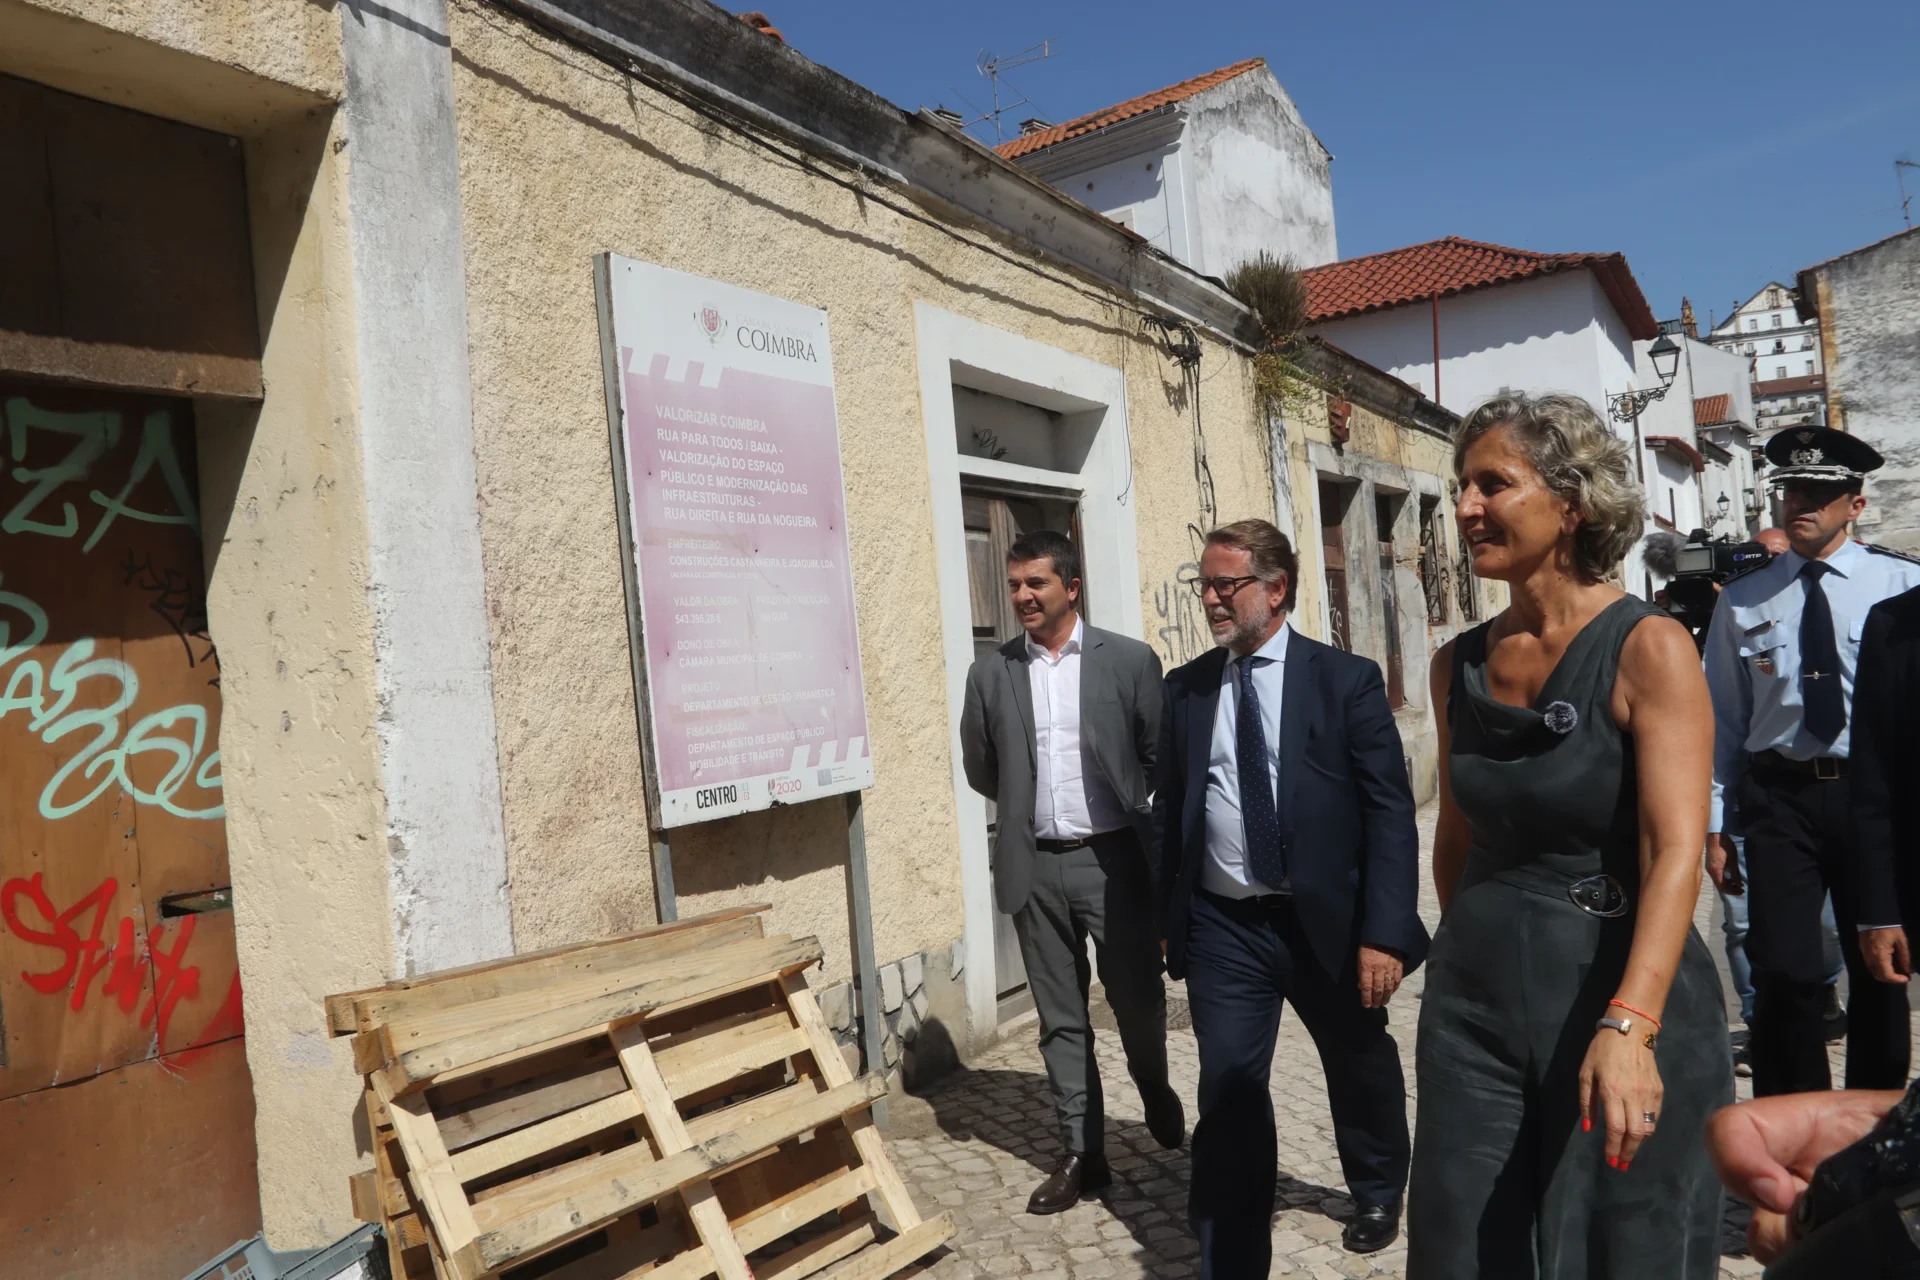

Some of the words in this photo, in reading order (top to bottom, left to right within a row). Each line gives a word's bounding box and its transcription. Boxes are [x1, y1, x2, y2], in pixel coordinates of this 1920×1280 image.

[736, 326, 818, 363] COIMBRA
[655, 404, 718, 426] VALORIZAR
[720, 414, 768, 433] COIMBRA
[657, 428, 679, 443] RUA
[681, 432, 709, 446] PARA
[711, 435, 744, 451] TODOS
[750, 440, 778, 455] BAIXA
[659, 450, 730, 469] VALORIZAÇÃO
[731, 457, 746, 470] DO
[748, 459, 784, 476] ESPAÇO
[661, 468, 705, 486] PÚBLICO
[707, 475, 714, 487] E
[716, 475, 788, 496] MODERNIZAÇÃO
[790, 482, 808, 495] DAS
[662, 488, 756, 507] INFRAESTRUTURAS
[664, 507, 687, 520] RUA
[688, 509, 727, 523] DIREITA
[728, 511, 735, 523] E
[737, 512, 757, 525] RUA
[758, 513, 772, 525] DA
[773, 514, 818, 528] NOGUEIRA
[669, 554, 730, 569] CONSTRUÇÕES
[730, 557, 782, 569] CASTANHEIRA
[782, 558, 788, 568] E
[673, 596, 703, 607] VALOR
[679, 655, 716, 668] CÂMARA
[716, 653, 759, 665] MUNICIPAL
[683, 697, 750, 712] DEPARTAMENTO
[750, 695, 761, 706] DE
[762, 690, 792, 704] GESTÃO
[688, 736, 754, 754] DEPARTAMENTO
[755, 734, 766, 745] DE
[766, 731, 795, 744] ESPAÇO
[796, 726, 825, 740] PÚBLICO
[689, 755, 740, 770] MOBILIDADE
[741, 754, 748, 764] E
[749, 747, 785, 761] TRÂNSITO
[696, 784, 738, 810] CENTRO
[776, 779, 802, 795] 2020
